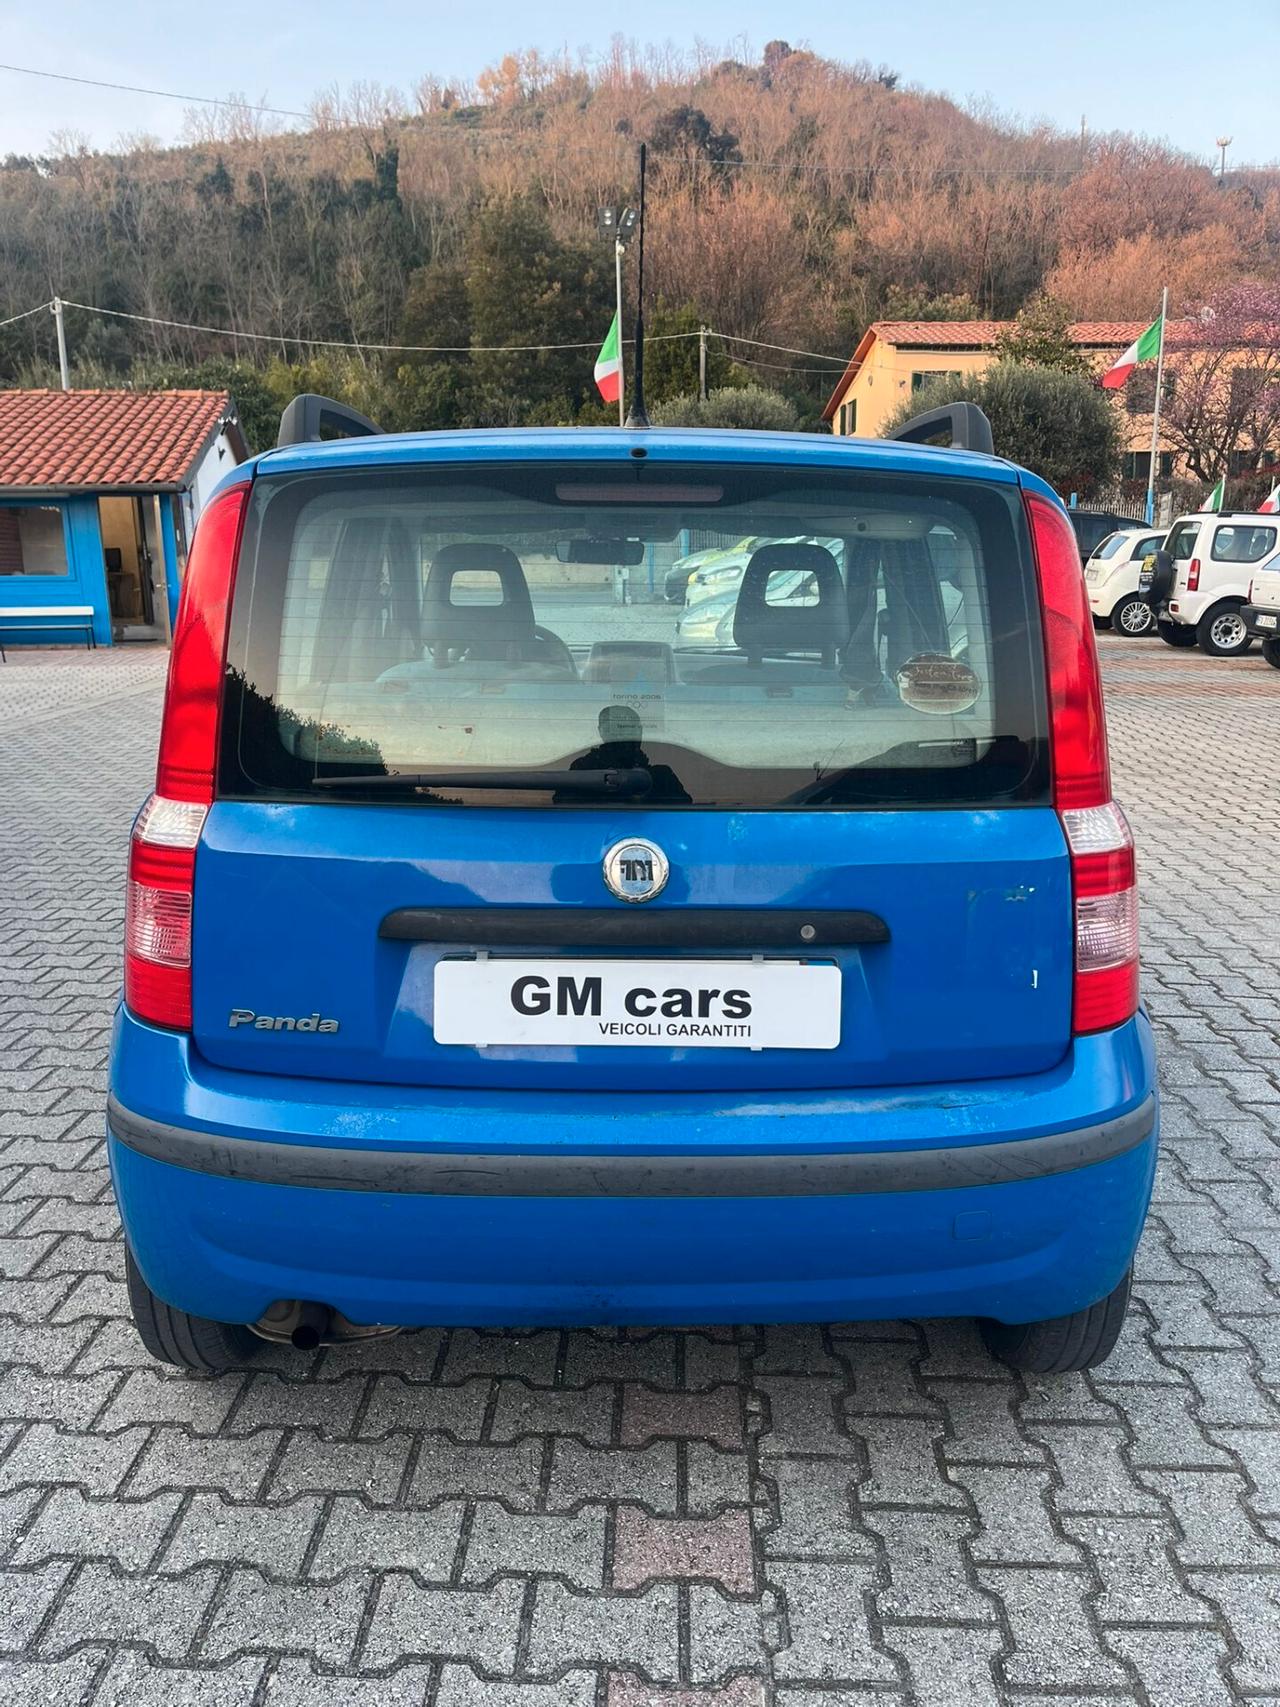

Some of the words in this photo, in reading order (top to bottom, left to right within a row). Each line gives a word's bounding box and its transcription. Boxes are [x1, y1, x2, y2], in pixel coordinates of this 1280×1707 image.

[510, 975, 602, 1016] GM
[624, 987, 752, 1019] cars
[228, 1008, 339, 1033] Panda
[599, 1022, 661, 1037] VEICOLI
[666, 1023, 751, 1038] GARANTITI
